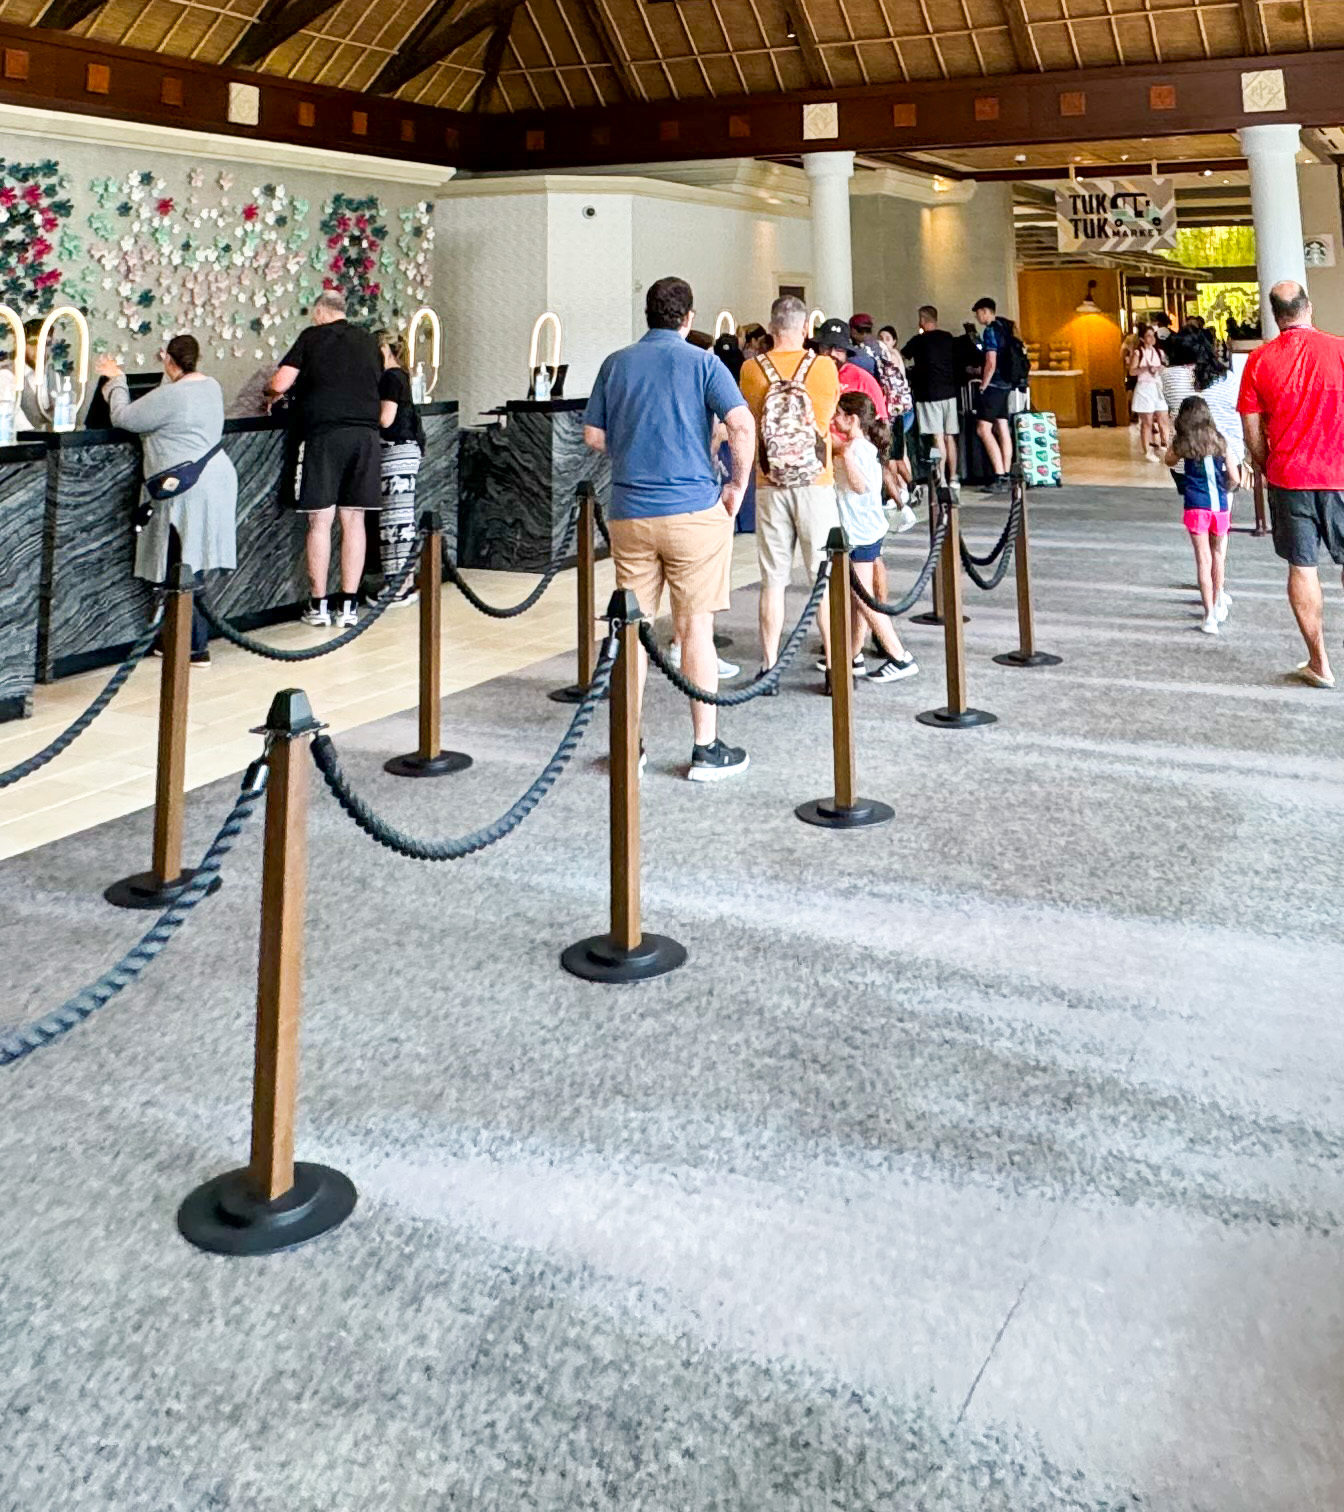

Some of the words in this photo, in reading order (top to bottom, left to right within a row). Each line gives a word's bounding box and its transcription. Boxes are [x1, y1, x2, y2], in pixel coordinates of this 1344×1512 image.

[1069, 193, 1107, 215] TUK
[1069, 218, 1110, 239] TUK
[1112, 228, 1162, 238] MARKET
